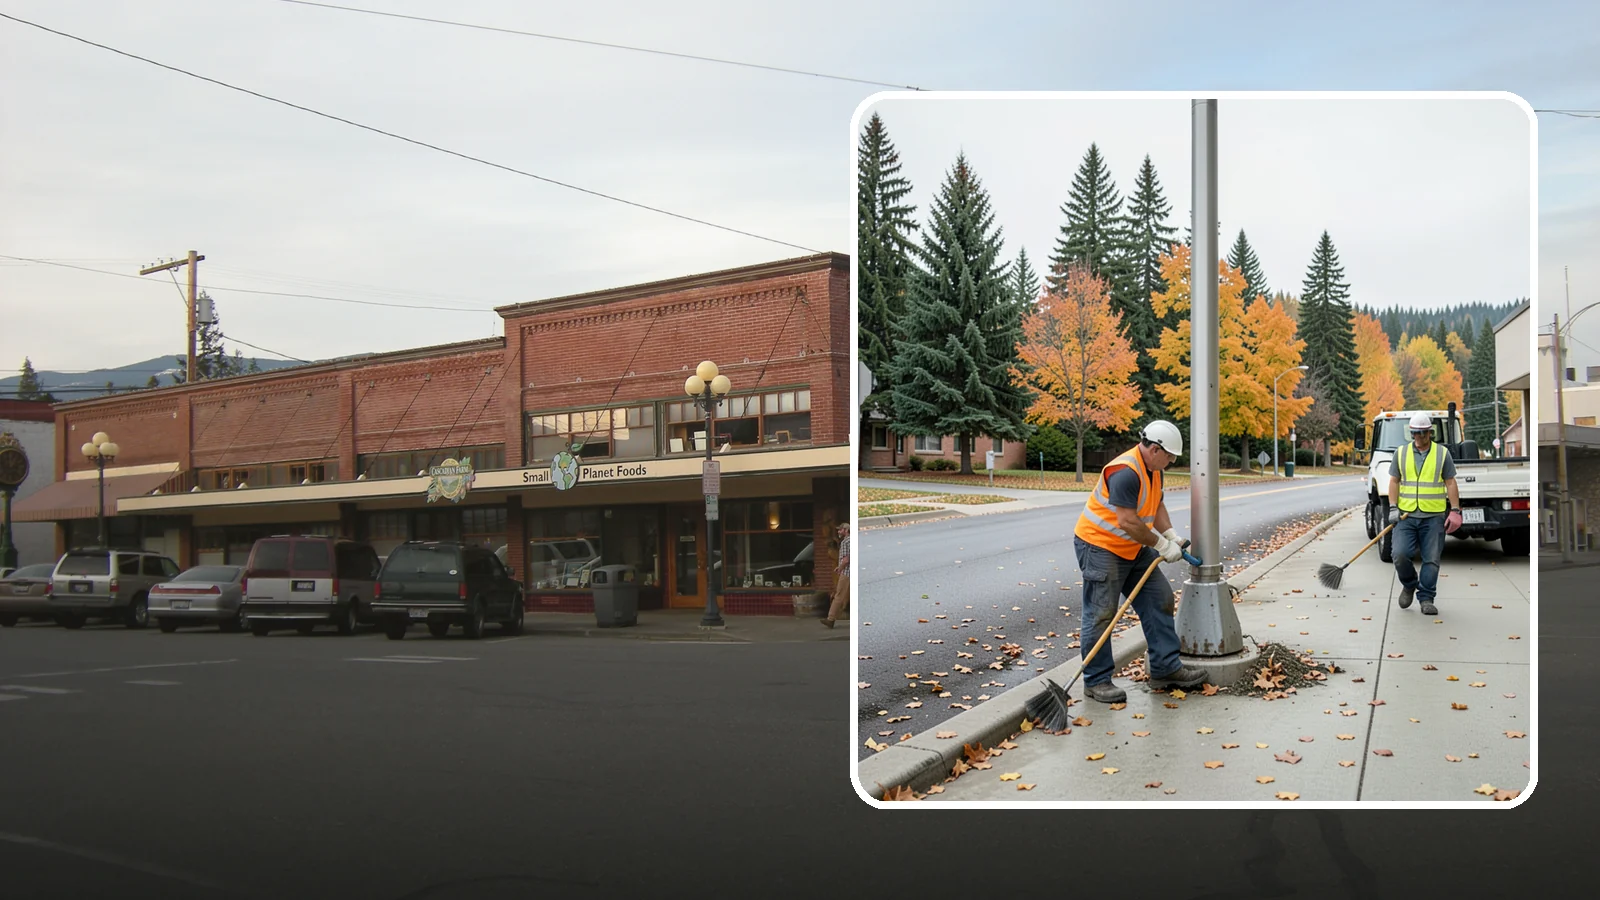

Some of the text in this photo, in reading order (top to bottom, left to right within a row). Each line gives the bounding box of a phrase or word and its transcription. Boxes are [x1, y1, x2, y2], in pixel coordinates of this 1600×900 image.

[523, 464, 647, 483] Small Planet Foods
